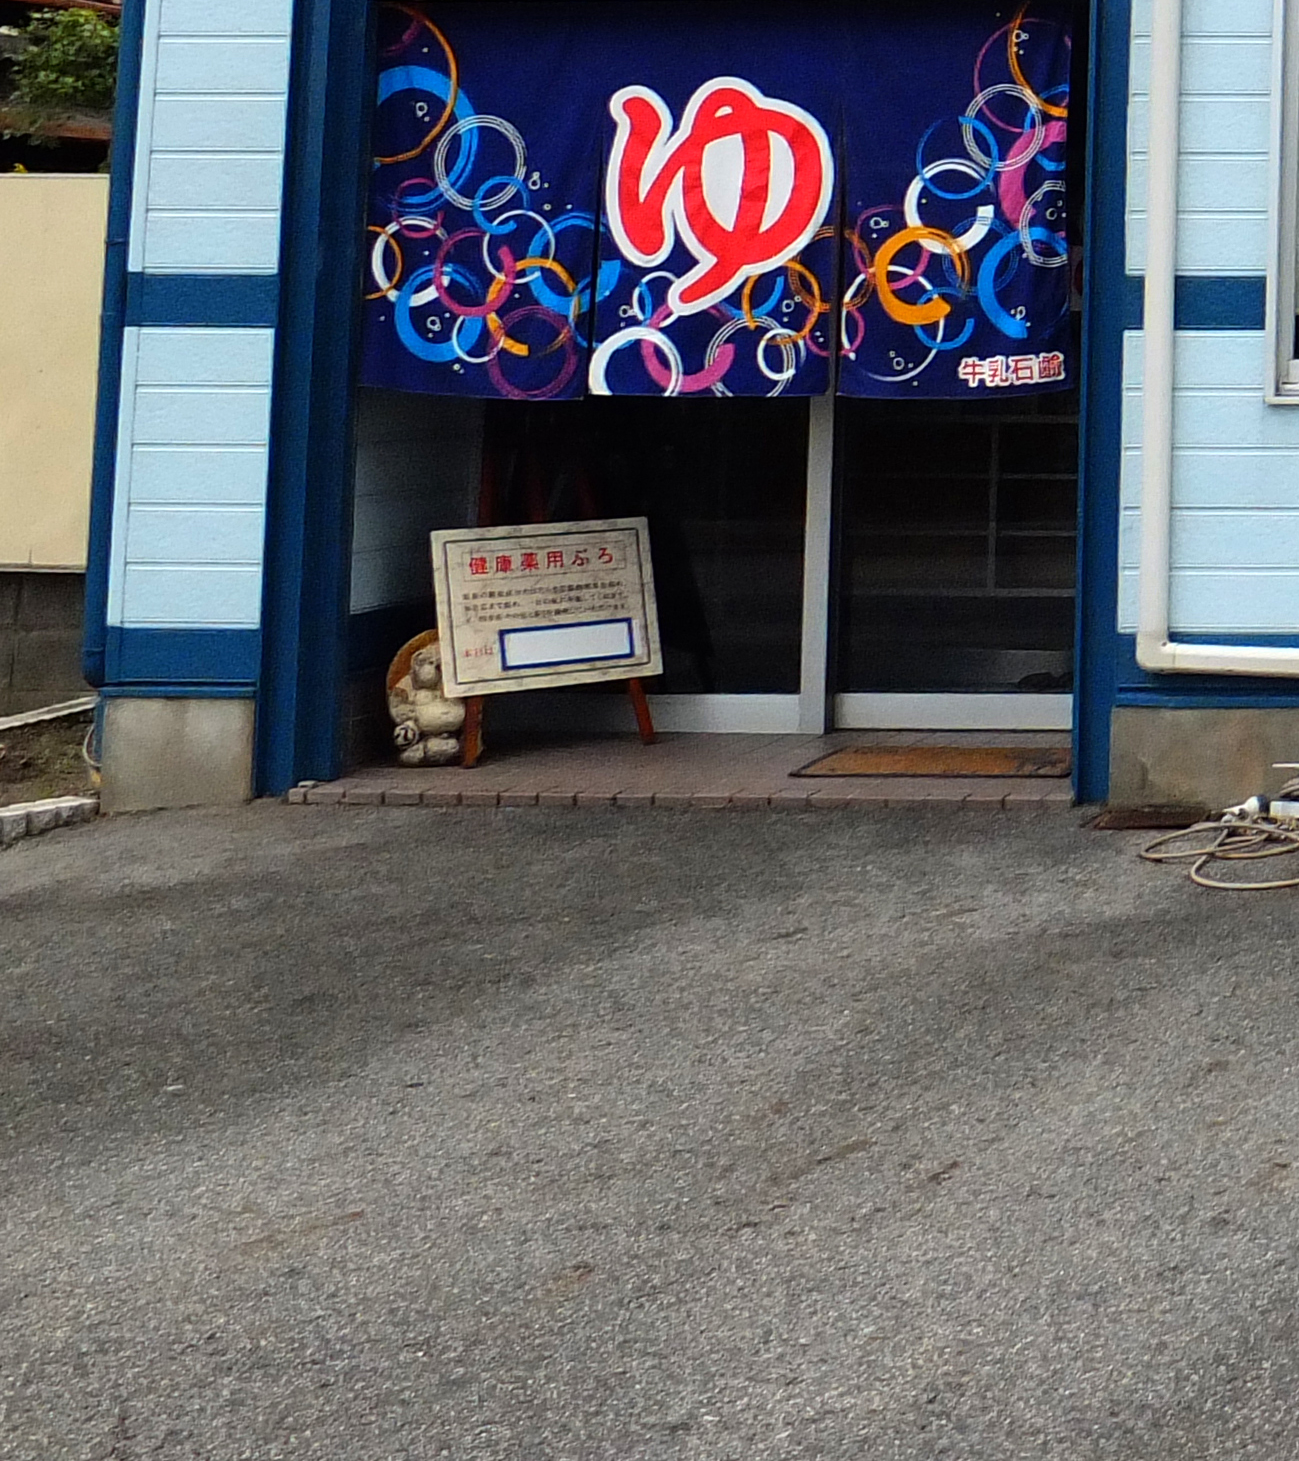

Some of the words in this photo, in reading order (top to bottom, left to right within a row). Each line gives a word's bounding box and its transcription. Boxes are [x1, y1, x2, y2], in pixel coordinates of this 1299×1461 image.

[608, 78, 832, 313] ゆ
[468, 546, 615, 576] 健康薬用ぶろ
